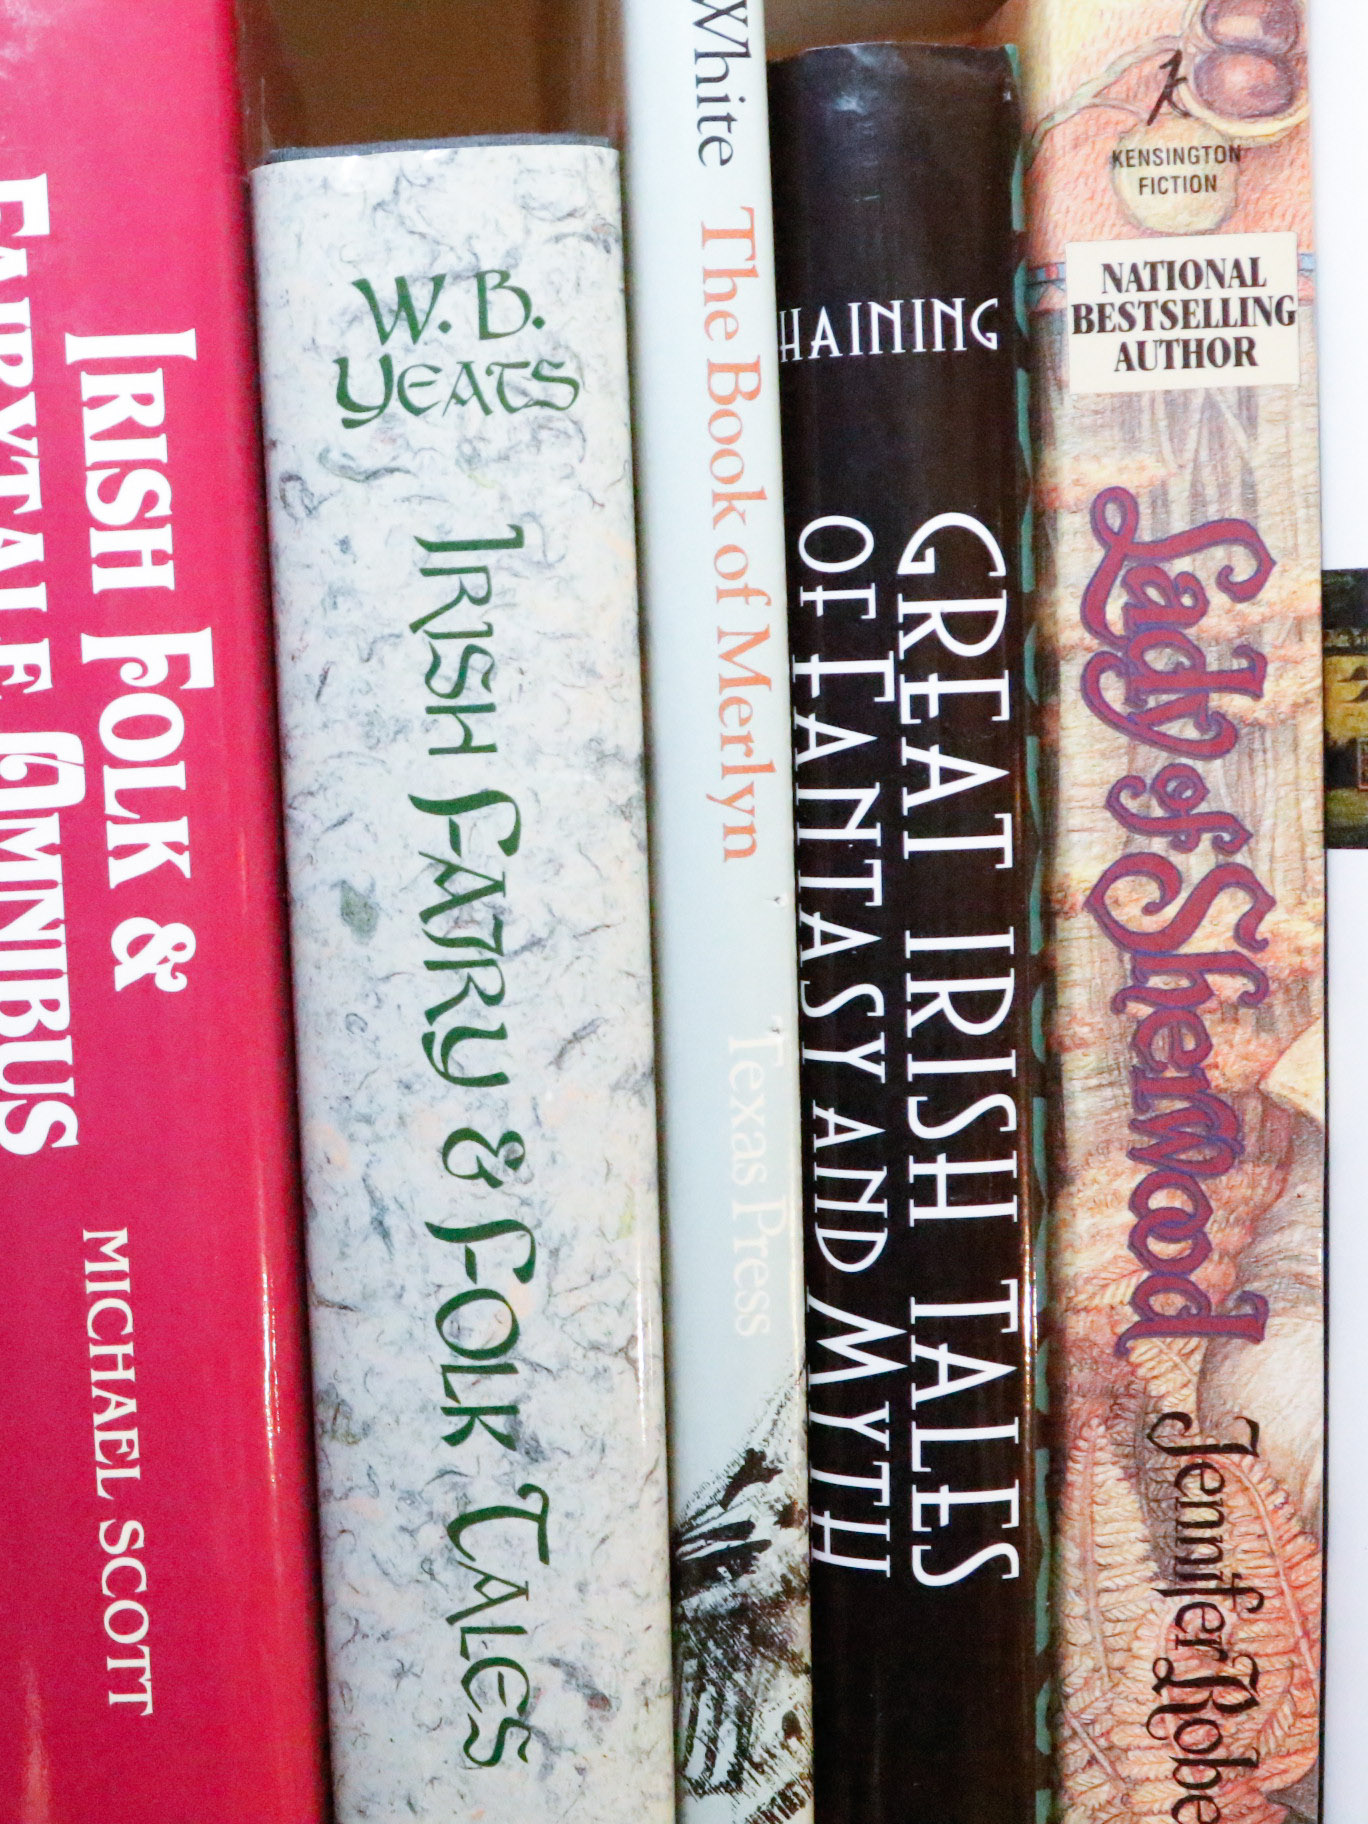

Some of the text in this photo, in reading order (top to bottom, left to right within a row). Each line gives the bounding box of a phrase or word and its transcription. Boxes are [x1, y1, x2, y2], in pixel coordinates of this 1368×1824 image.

[695, 0, 751, 166] White
[1111, 145, 1241, 168] KENSINGTON
[1138, 174, 1218, 195] FICTION
[353, 272, 544, 345] W. B.
[780, 297, 998, 362] HAINING
[1072, 295, 1296, 335] BESTSELLING
[1103, 257, 1267, 293] NATIONAL
[1119, 336, 1257, 372] AUTHOR
[409, 525, 523, 756] IRISH
[700, 207, 778, 862] The Book of Merlyn
[64, 327, 215, 993] IRISH FOLK &
[1079, 485, 1278, 1357] Lady of Sherwood
[441, 1127, 525, 1189] &
[791, 515, 907, 1578] OF FANTASY AND MYTH
[897, 512, 1020, 1587] GREAT IRISH TALES
[728, 1015, 788, 1338] Texas Press
[424, 1219, 536, 1452] FOLK
[82, 1227, 153, 1716] MICHAEL SCOTT
[1146, 1410, 1264, 1824] Jennifer Robe
